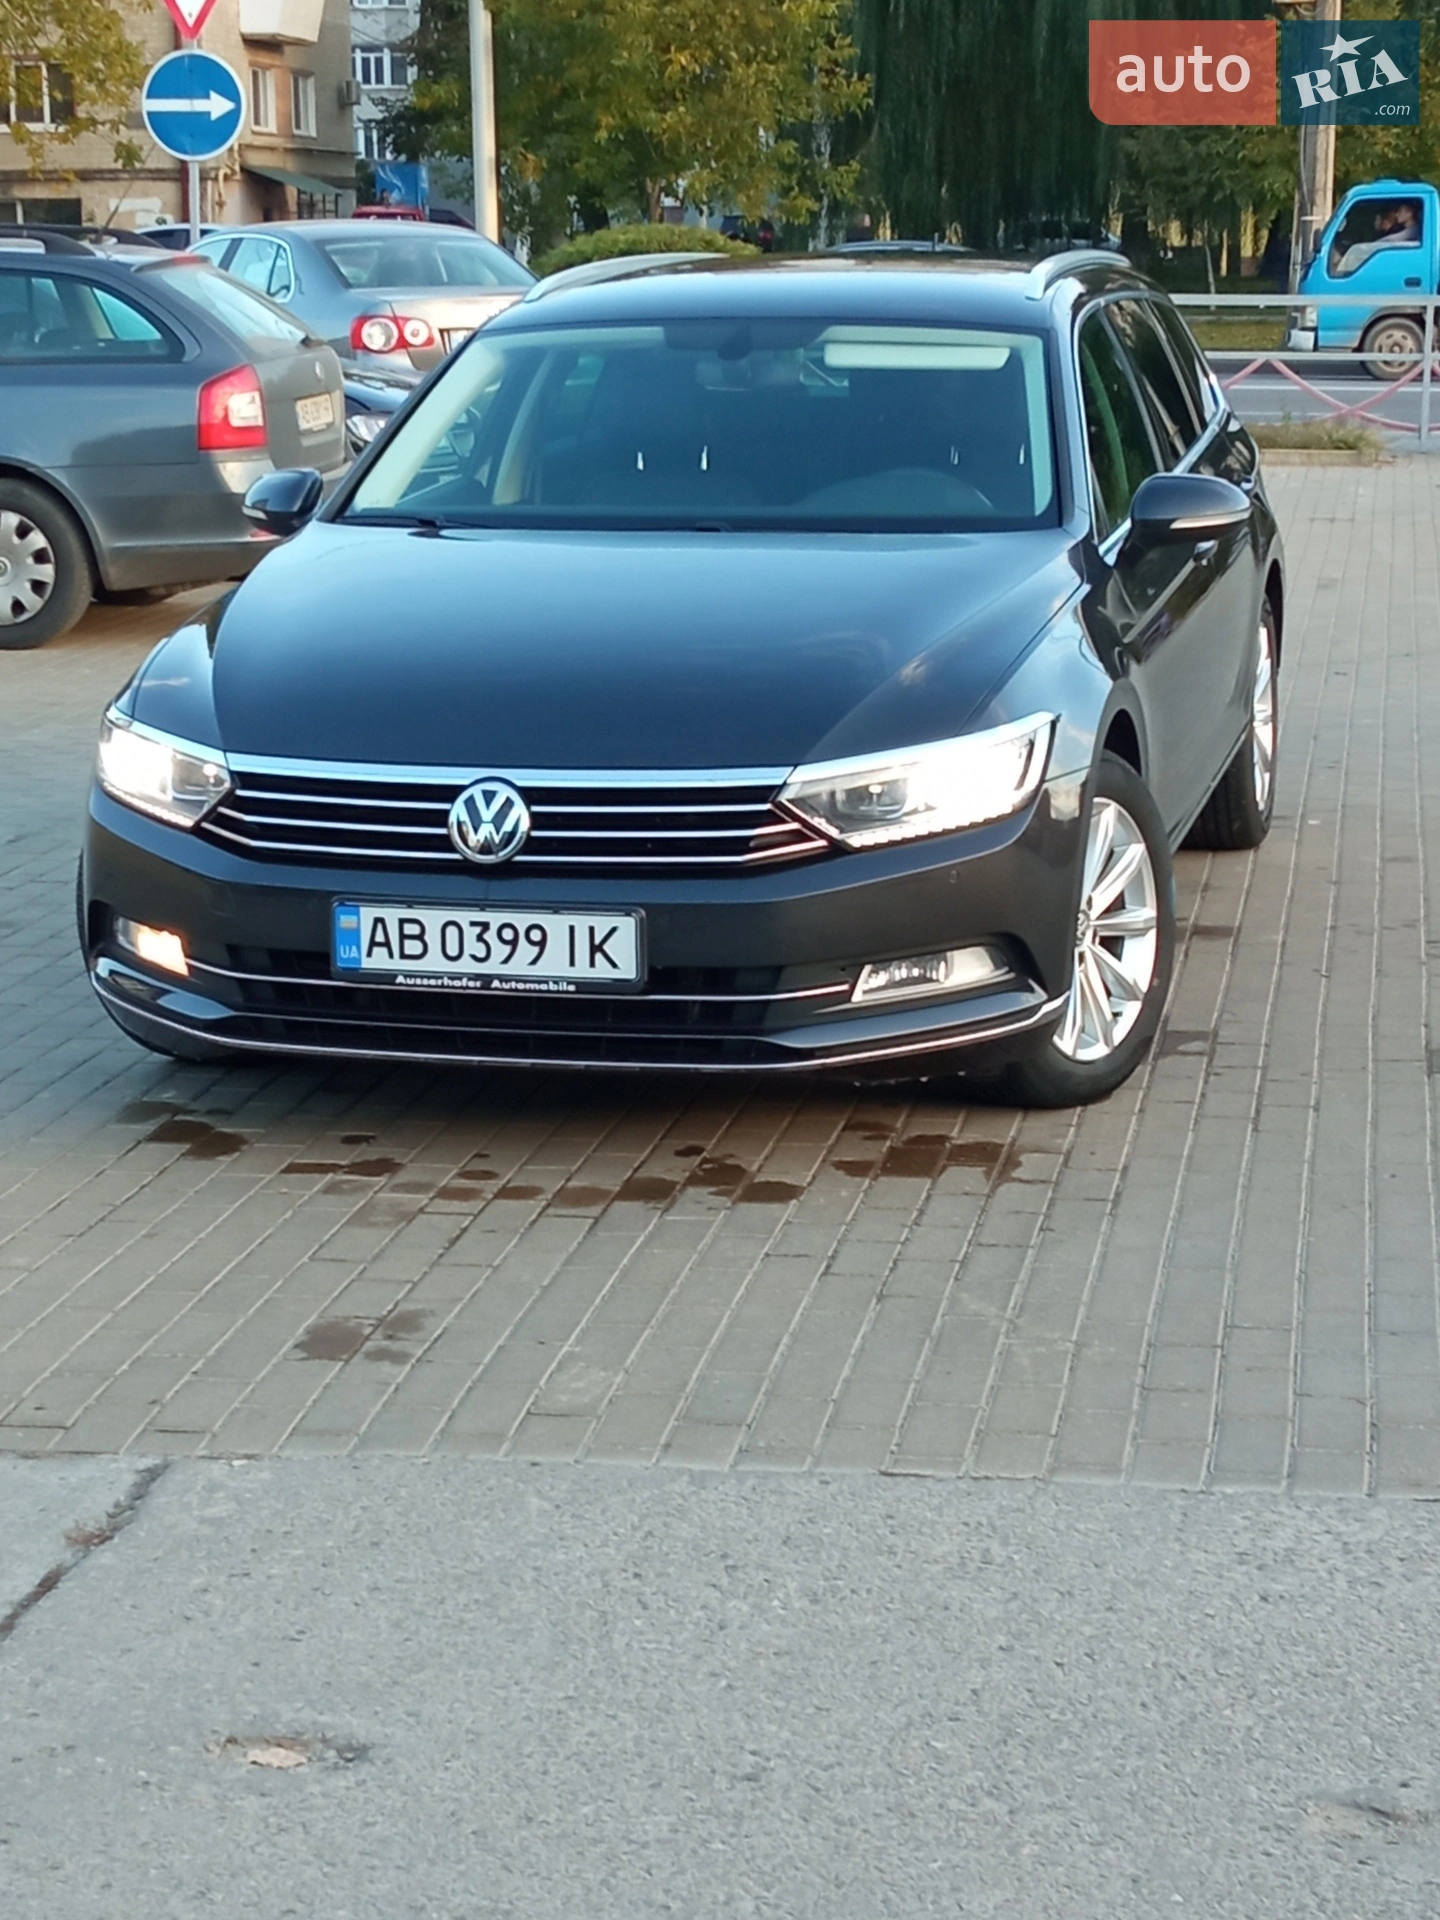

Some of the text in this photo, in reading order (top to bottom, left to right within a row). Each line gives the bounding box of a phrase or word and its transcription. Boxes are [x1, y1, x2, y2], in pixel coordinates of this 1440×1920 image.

[451, 783, 527, 860] VW
[340, 945, 360, 959] UA
[366, 916, 621, 970] AB 0399 IK
[490, 979, 577, 992] Automobile
